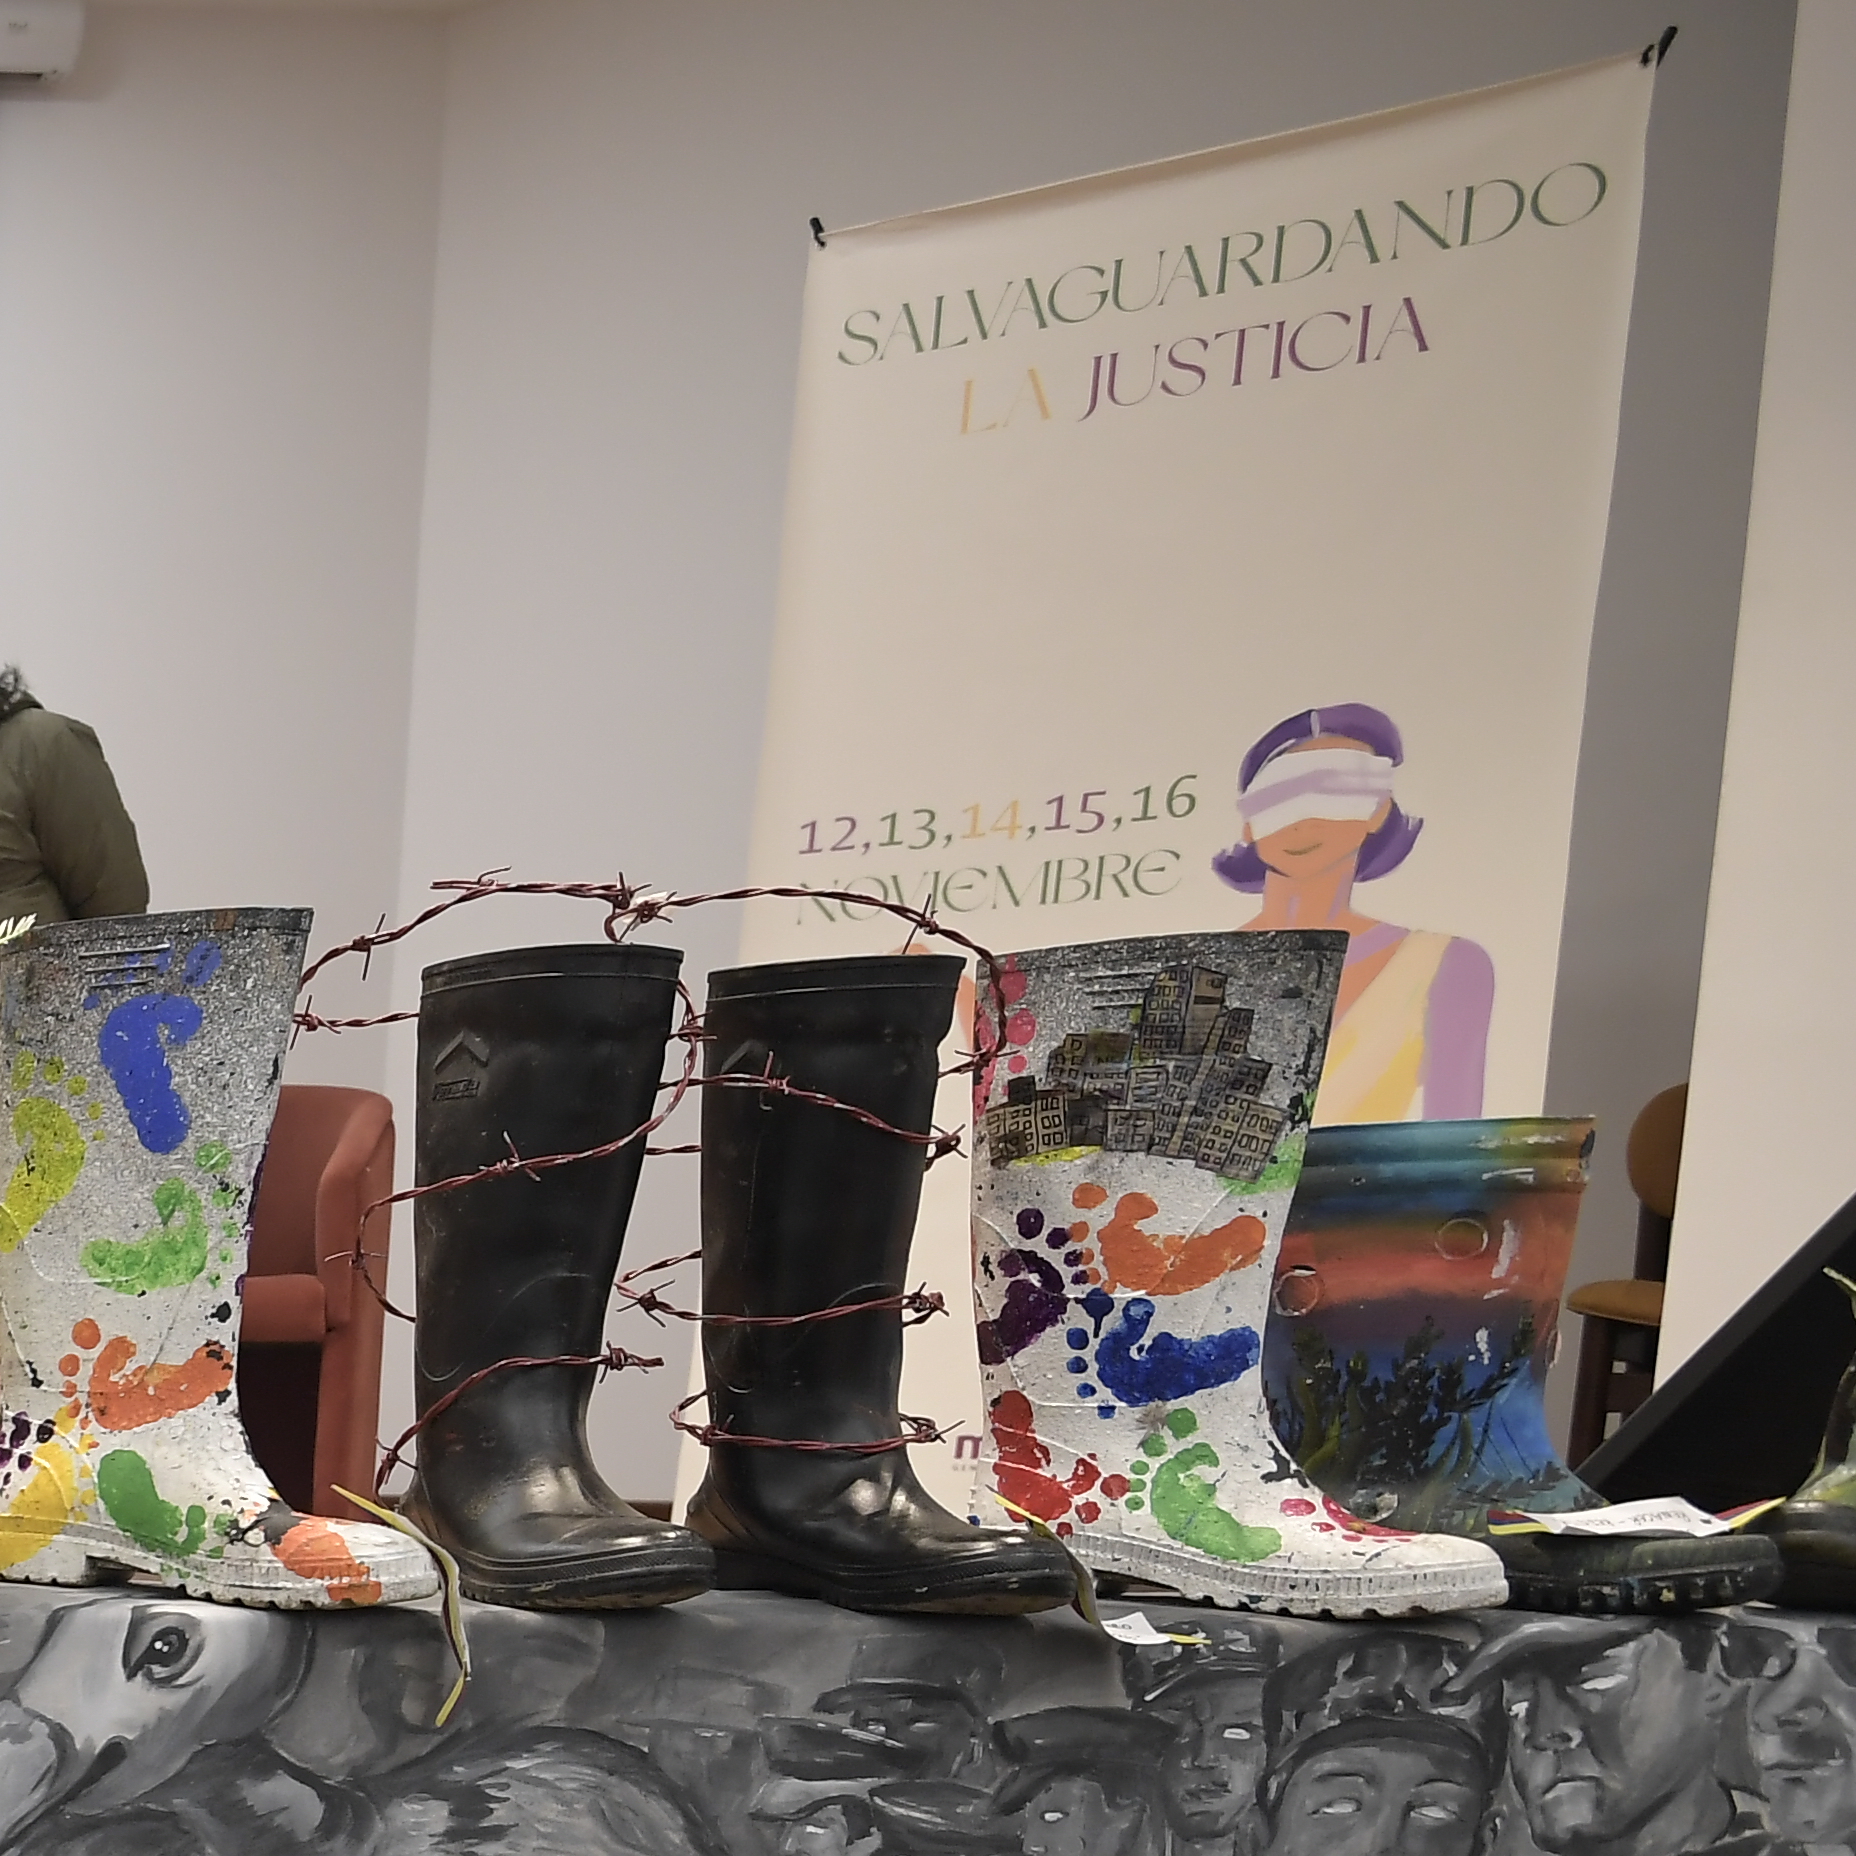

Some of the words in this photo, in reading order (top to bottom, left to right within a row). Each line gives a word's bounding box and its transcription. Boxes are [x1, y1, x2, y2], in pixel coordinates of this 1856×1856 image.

[836, 162, 1609, 367] SALVAGUARDANDO
[958, 367, 1052, 436] LA
[1078, 295, 1432, 422] JUSTICIA
[796, 848, 1183, 925] NOVIEMBRE
